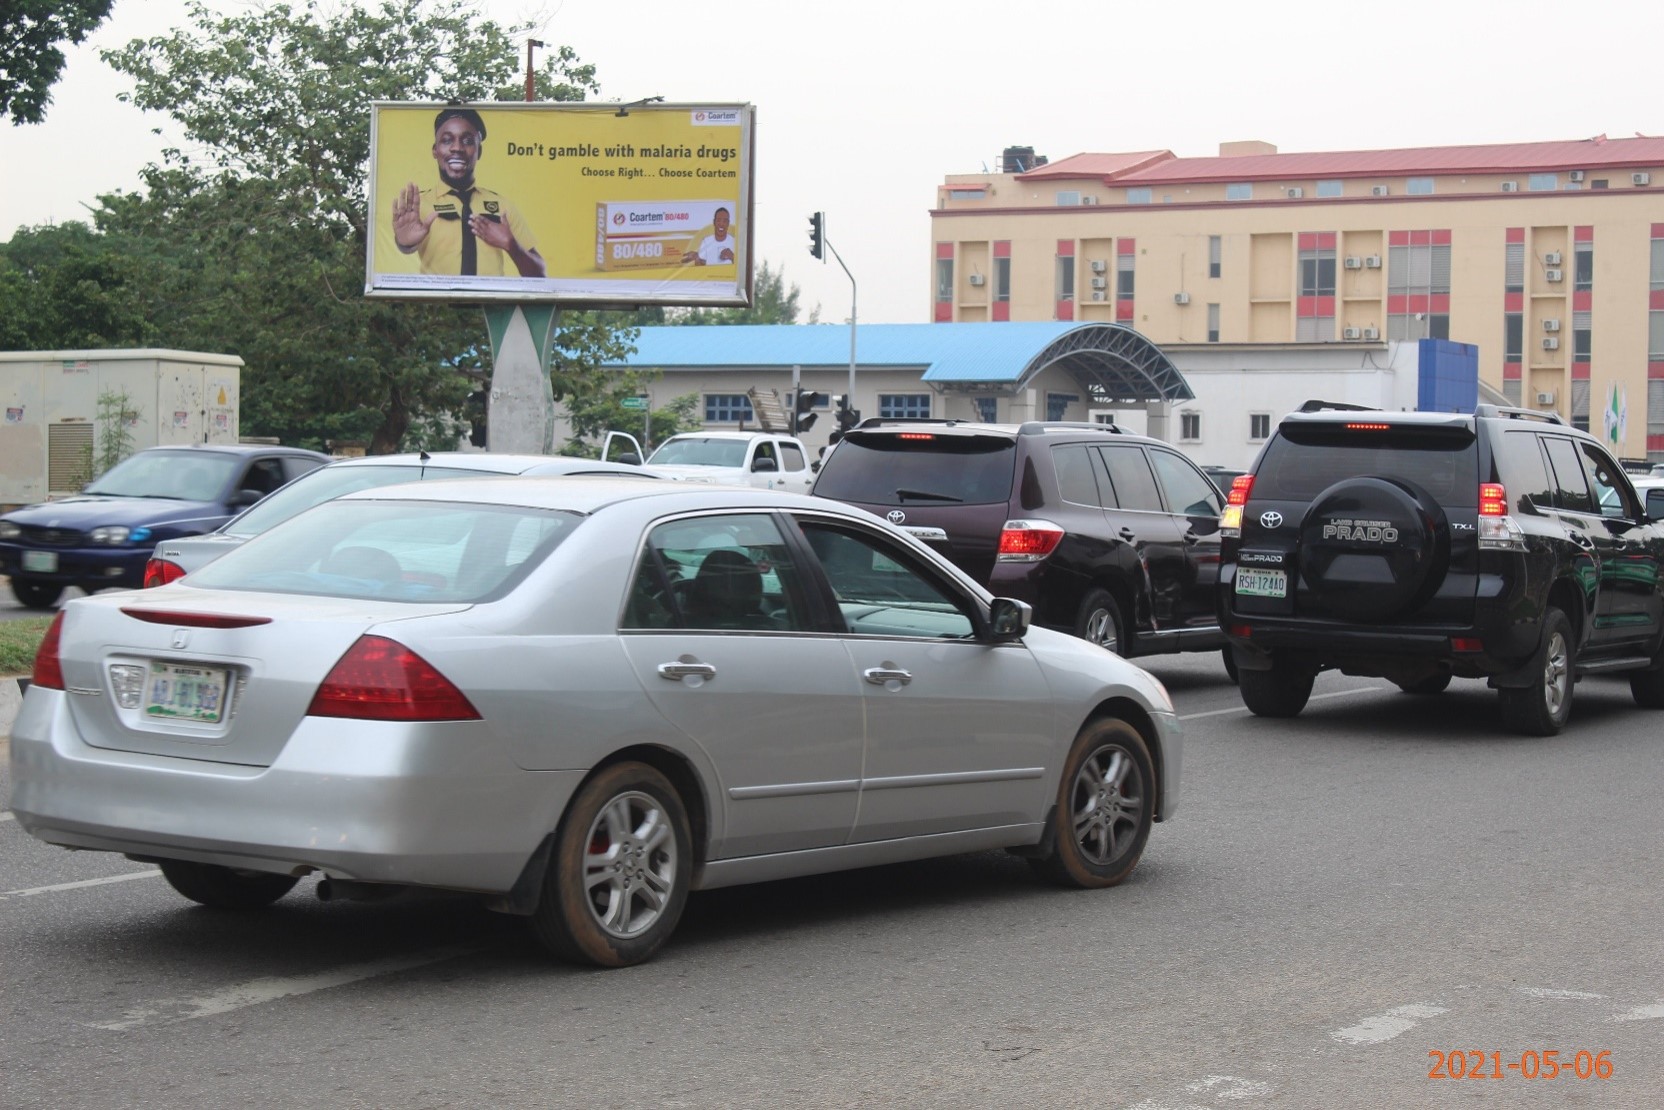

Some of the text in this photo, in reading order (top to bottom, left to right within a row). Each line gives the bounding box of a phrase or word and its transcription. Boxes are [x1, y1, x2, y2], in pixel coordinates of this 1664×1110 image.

[708, 112, 736, 120] Coartem
[507, 142, 737, 162] Don't gamble with malaria drugs
[581, 166, 615, 177] Choose
[658, 167, 693, 178] Choose
[696, 168, 737, 178] Coartem
[629, 212, 690, 222] Coartem 80/480
[613, 242, 663, 259] 80/480
[1323, 525, 1399, 543] PRADO
[1253, 554, 1283, 563] PRADO
